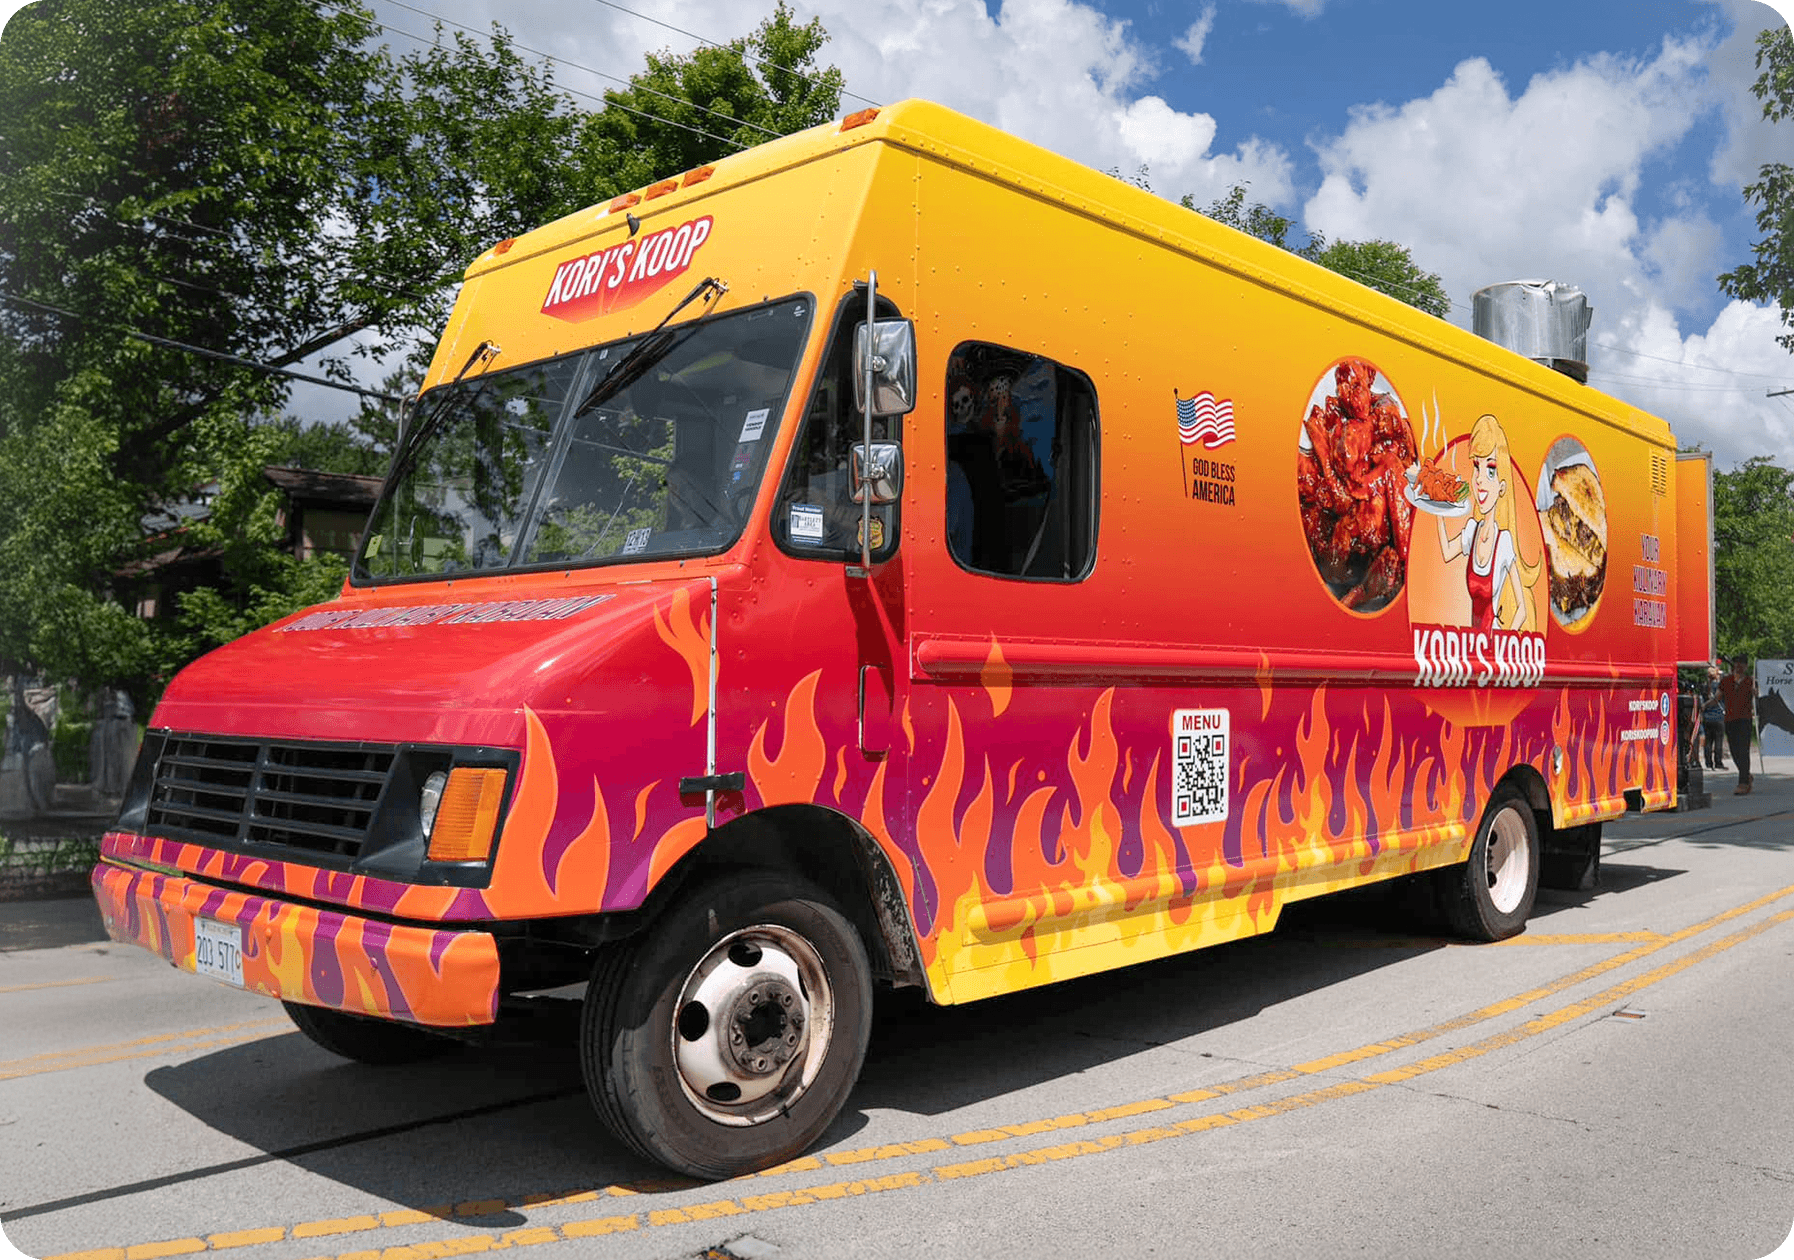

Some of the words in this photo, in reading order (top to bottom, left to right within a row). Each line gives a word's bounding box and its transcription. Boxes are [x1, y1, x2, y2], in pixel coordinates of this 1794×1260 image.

[544, 243, 634, 307] KORI'S
[628, 219, 710, 283] KOOP
[1193, 457, 1209, 477] GOD
[1211, 461, 1236, 483] BLESS
[1192, 479, 1236, 507] AMERICA
[1413, 629, 1493, 688] KORI'S
[1494, 634, 1546, 688] KOOP
[1766, 675, 1793, 685] Horse
[1182, 714, 1221, 731] MENU
